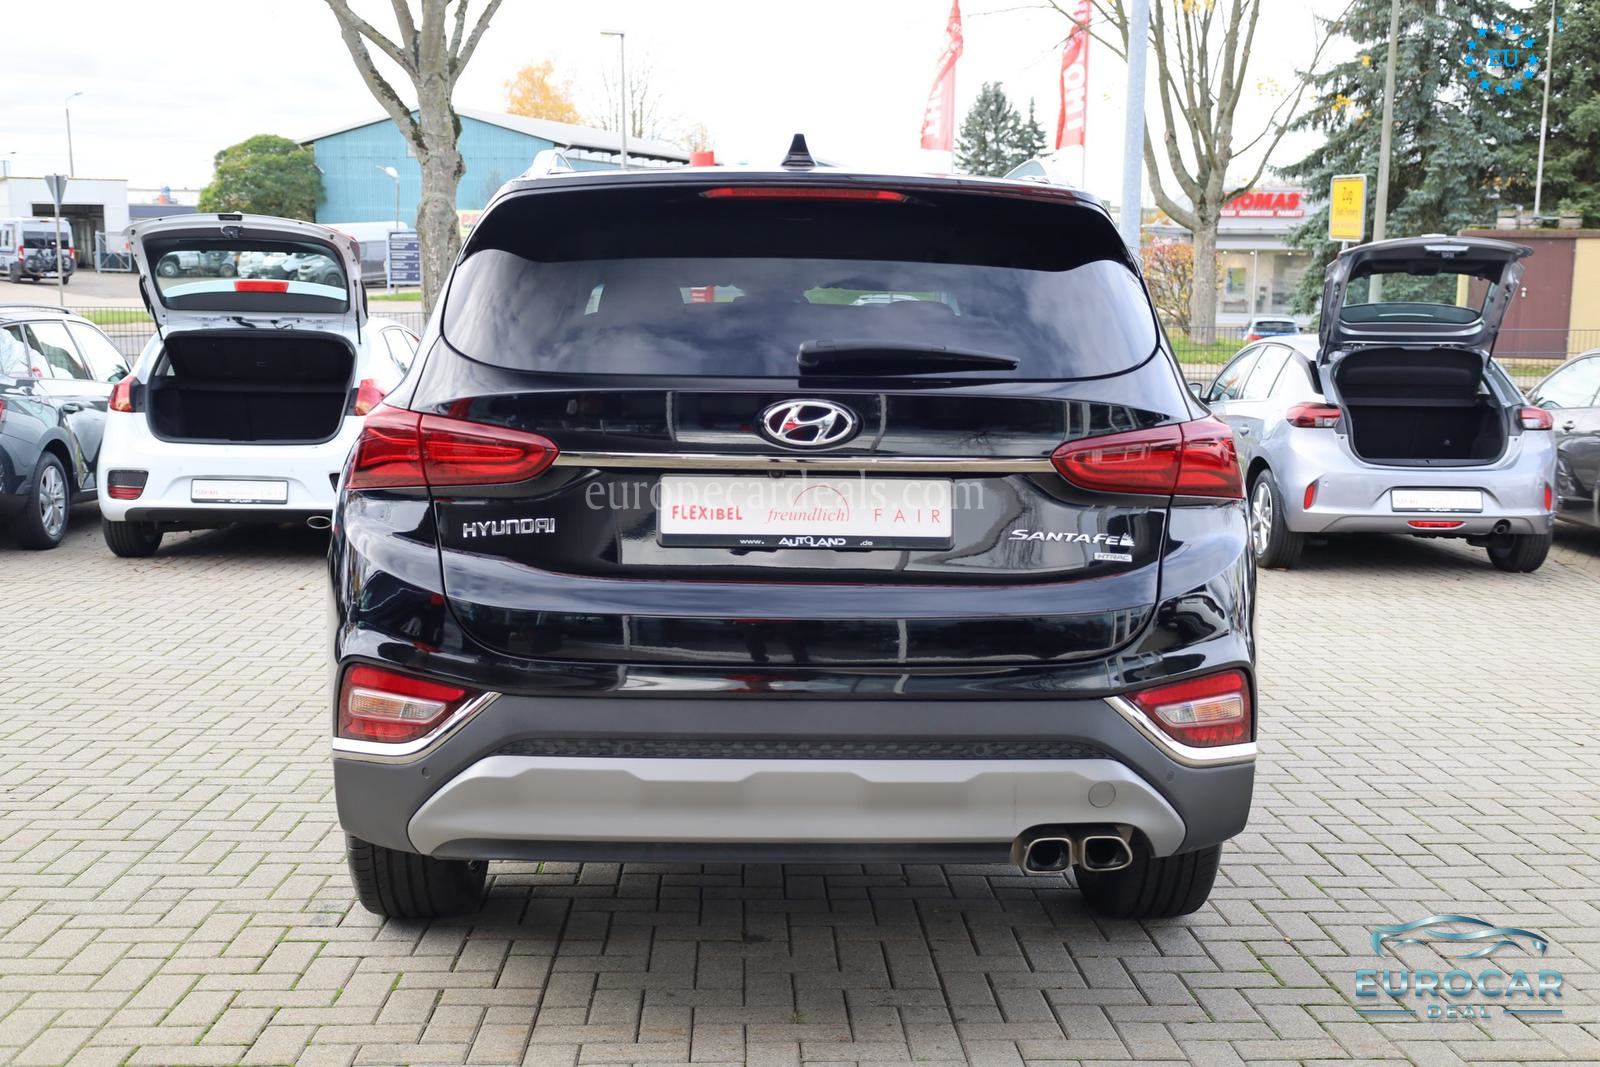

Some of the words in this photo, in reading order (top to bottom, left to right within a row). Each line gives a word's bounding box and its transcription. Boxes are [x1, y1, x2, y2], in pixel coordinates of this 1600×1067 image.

[671, 504, 743, 521] FLEXIBEL
[766, 506, 846, 524] freundlich
[462, 517, 556, 538] HYUNDAI
[778, 535, 847, 547] AUTOLAND
